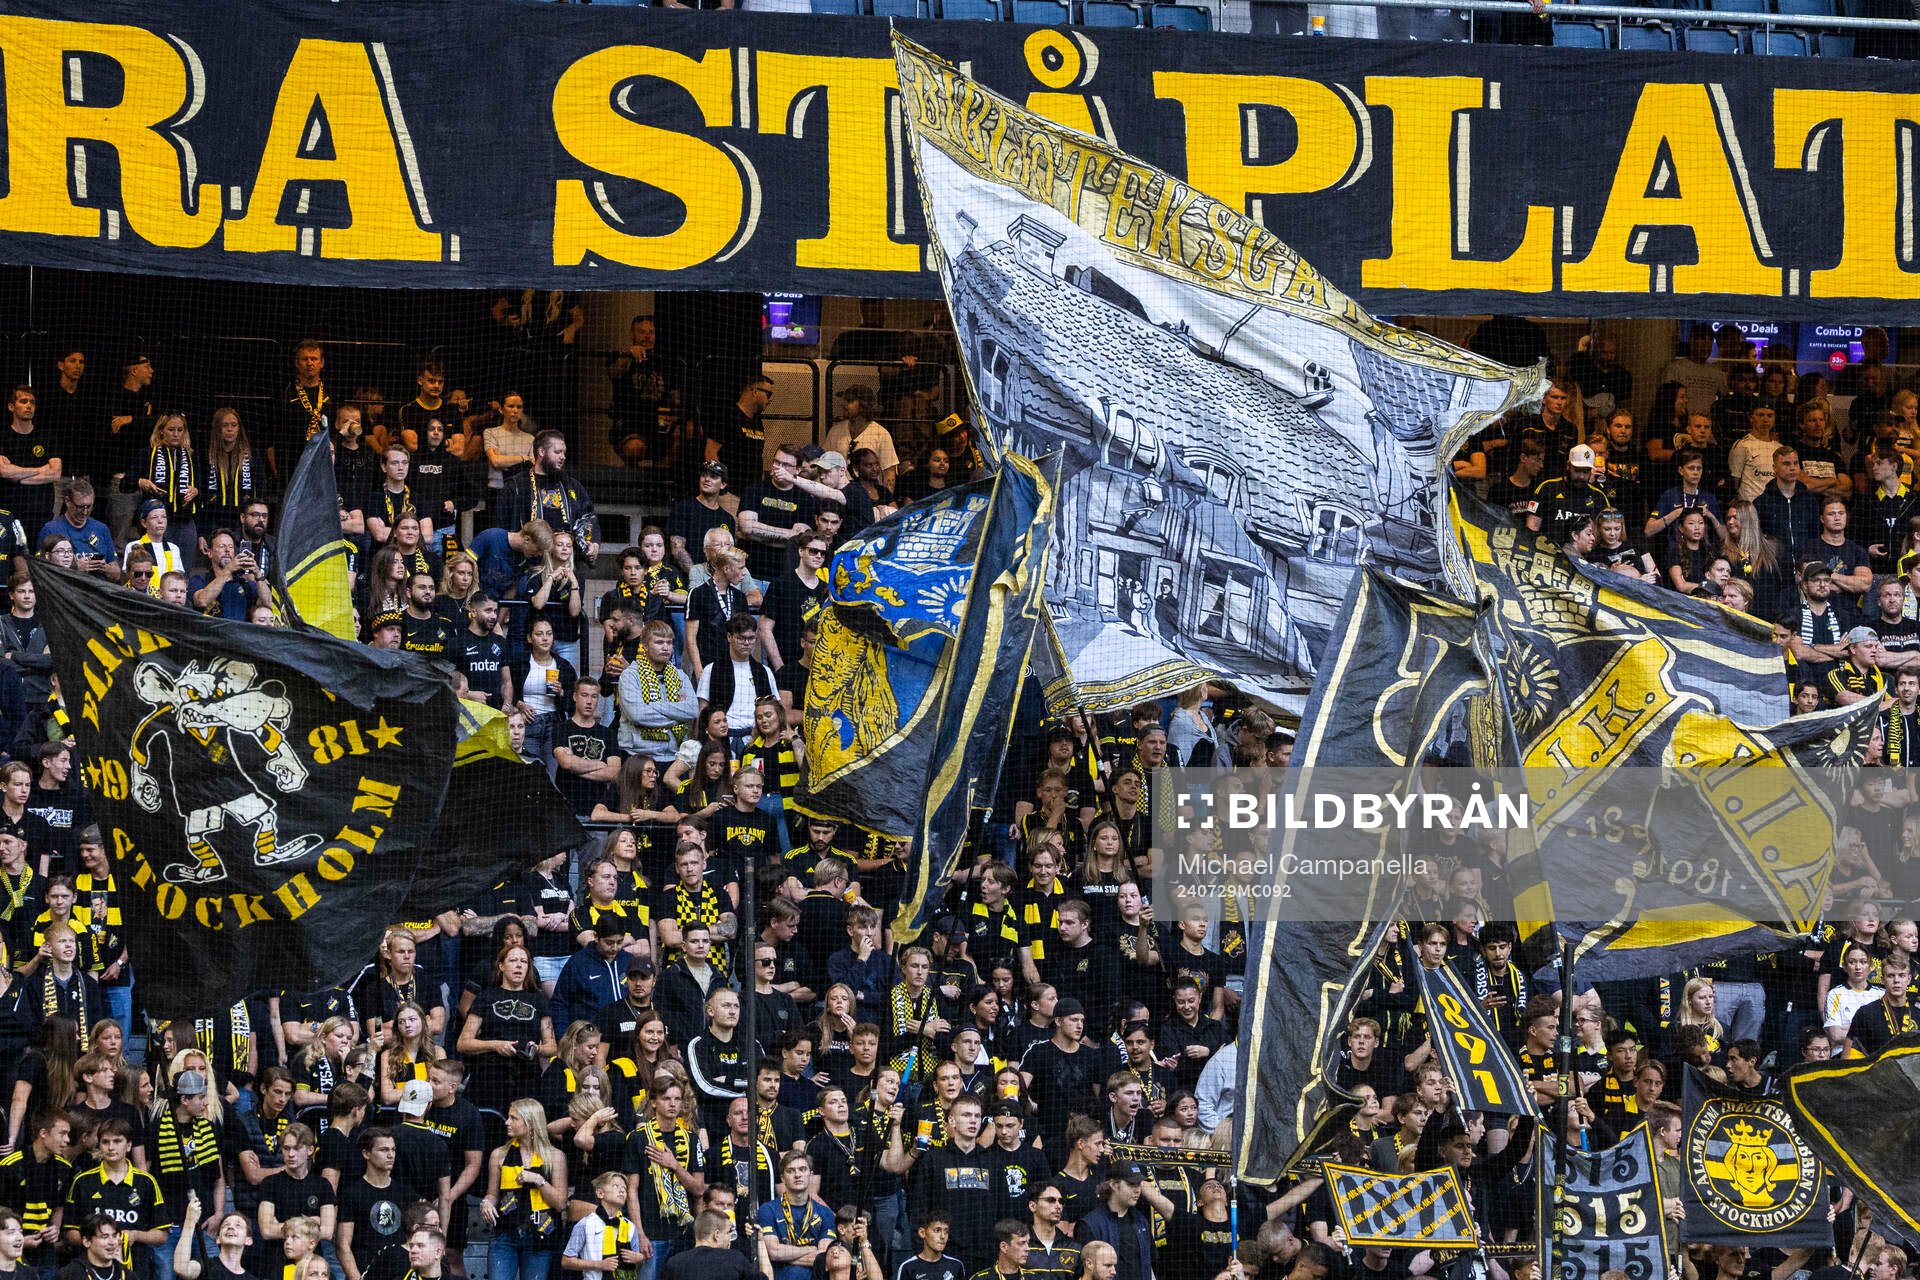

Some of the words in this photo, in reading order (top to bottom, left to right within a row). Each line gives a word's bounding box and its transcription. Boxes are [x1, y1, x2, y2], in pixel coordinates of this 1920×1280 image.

[0, 14, 460, 262] RA
[1712, 322, 1748, 332] Cbo
[1751, 323, 1779, 334] Deals
[1815, 326, 1852, 337] Combo
[470, 659, 500, 671] notar
[308, 720, 370, 764] 81
[726, 826, 747, 841] BLACK
[748, 828, 766, 844] ARMY
[112, 775, 401, 930] STOCKHOLM
[95, 1206, 138, 1223] BRO
[1563, 1189, 1647, 1238] 515
[1709, 1196, 1806, 1228] STOCKHOLM
